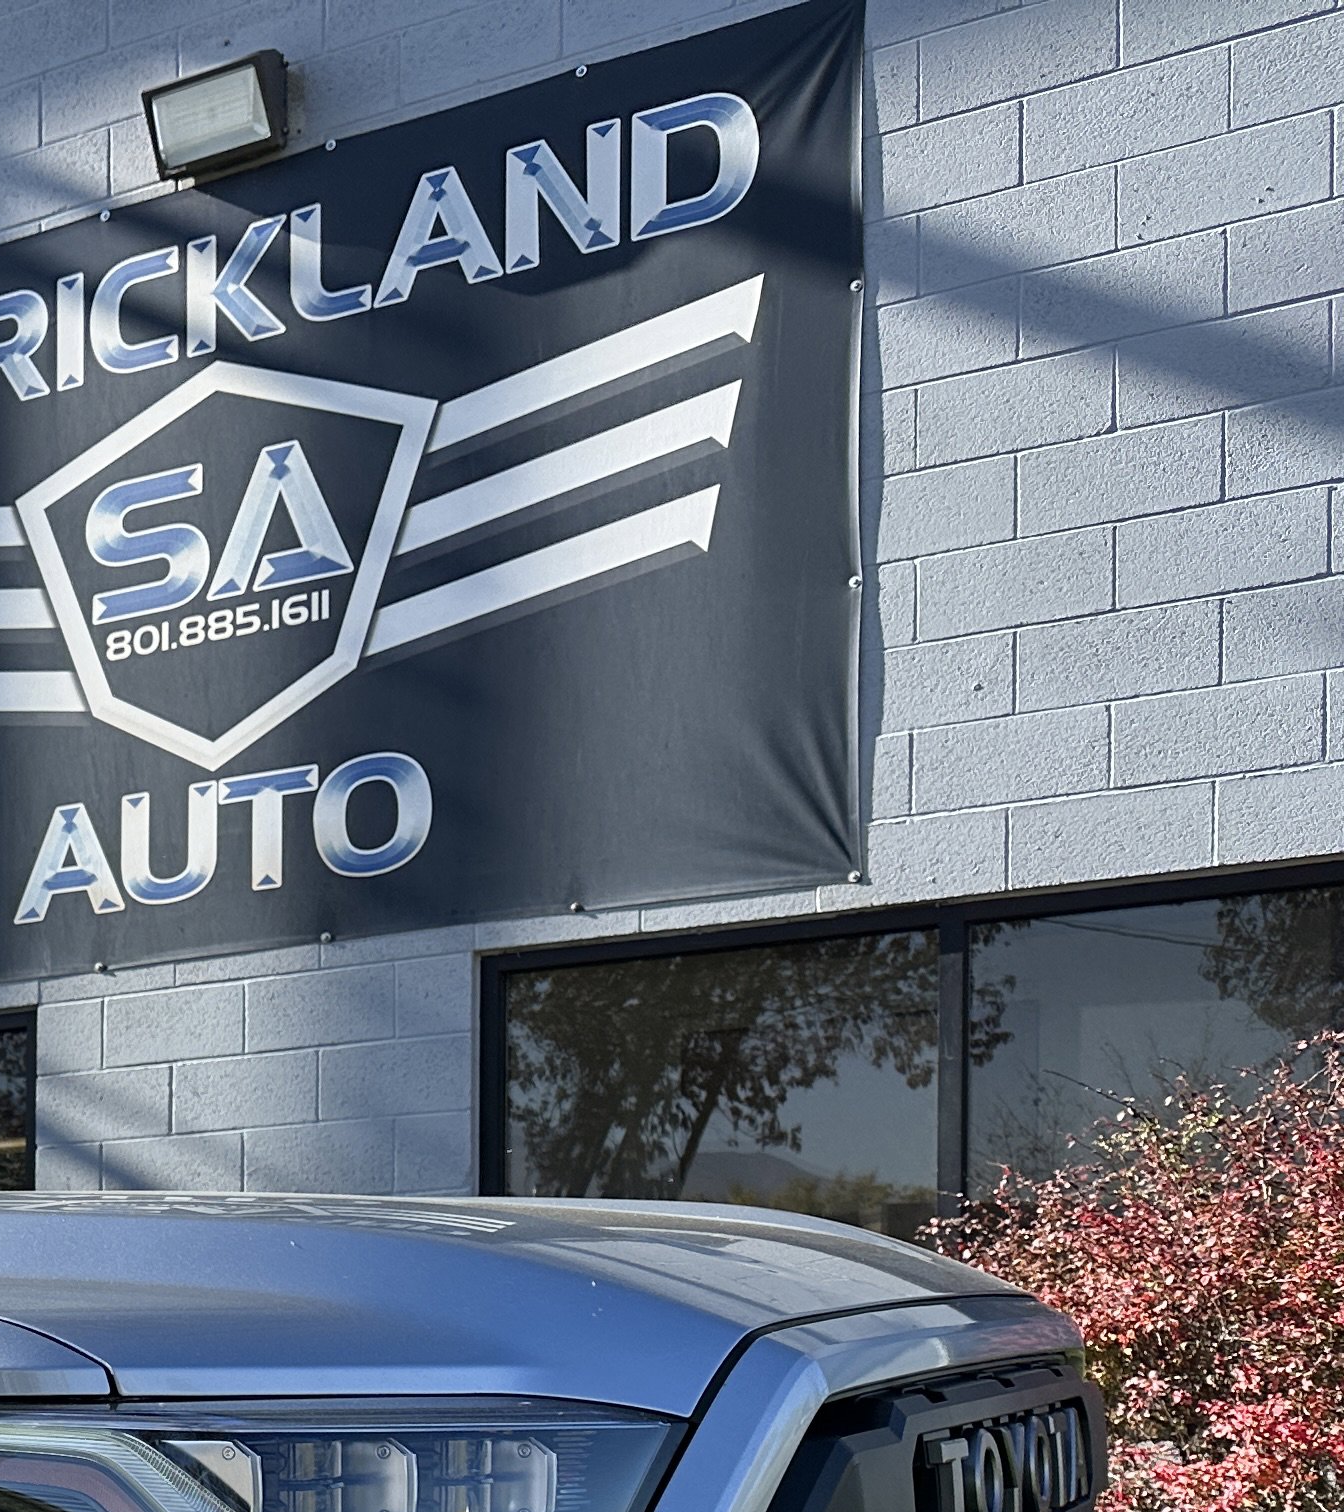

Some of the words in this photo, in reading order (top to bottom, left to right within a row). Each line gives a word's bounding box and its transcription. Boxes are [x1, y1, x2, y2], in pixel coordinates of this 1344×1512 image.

[85, 440, 354, 625] SA
[106, 589, 330, 661] 801.885.1611
[14, 752, 432, 924] AUTO
